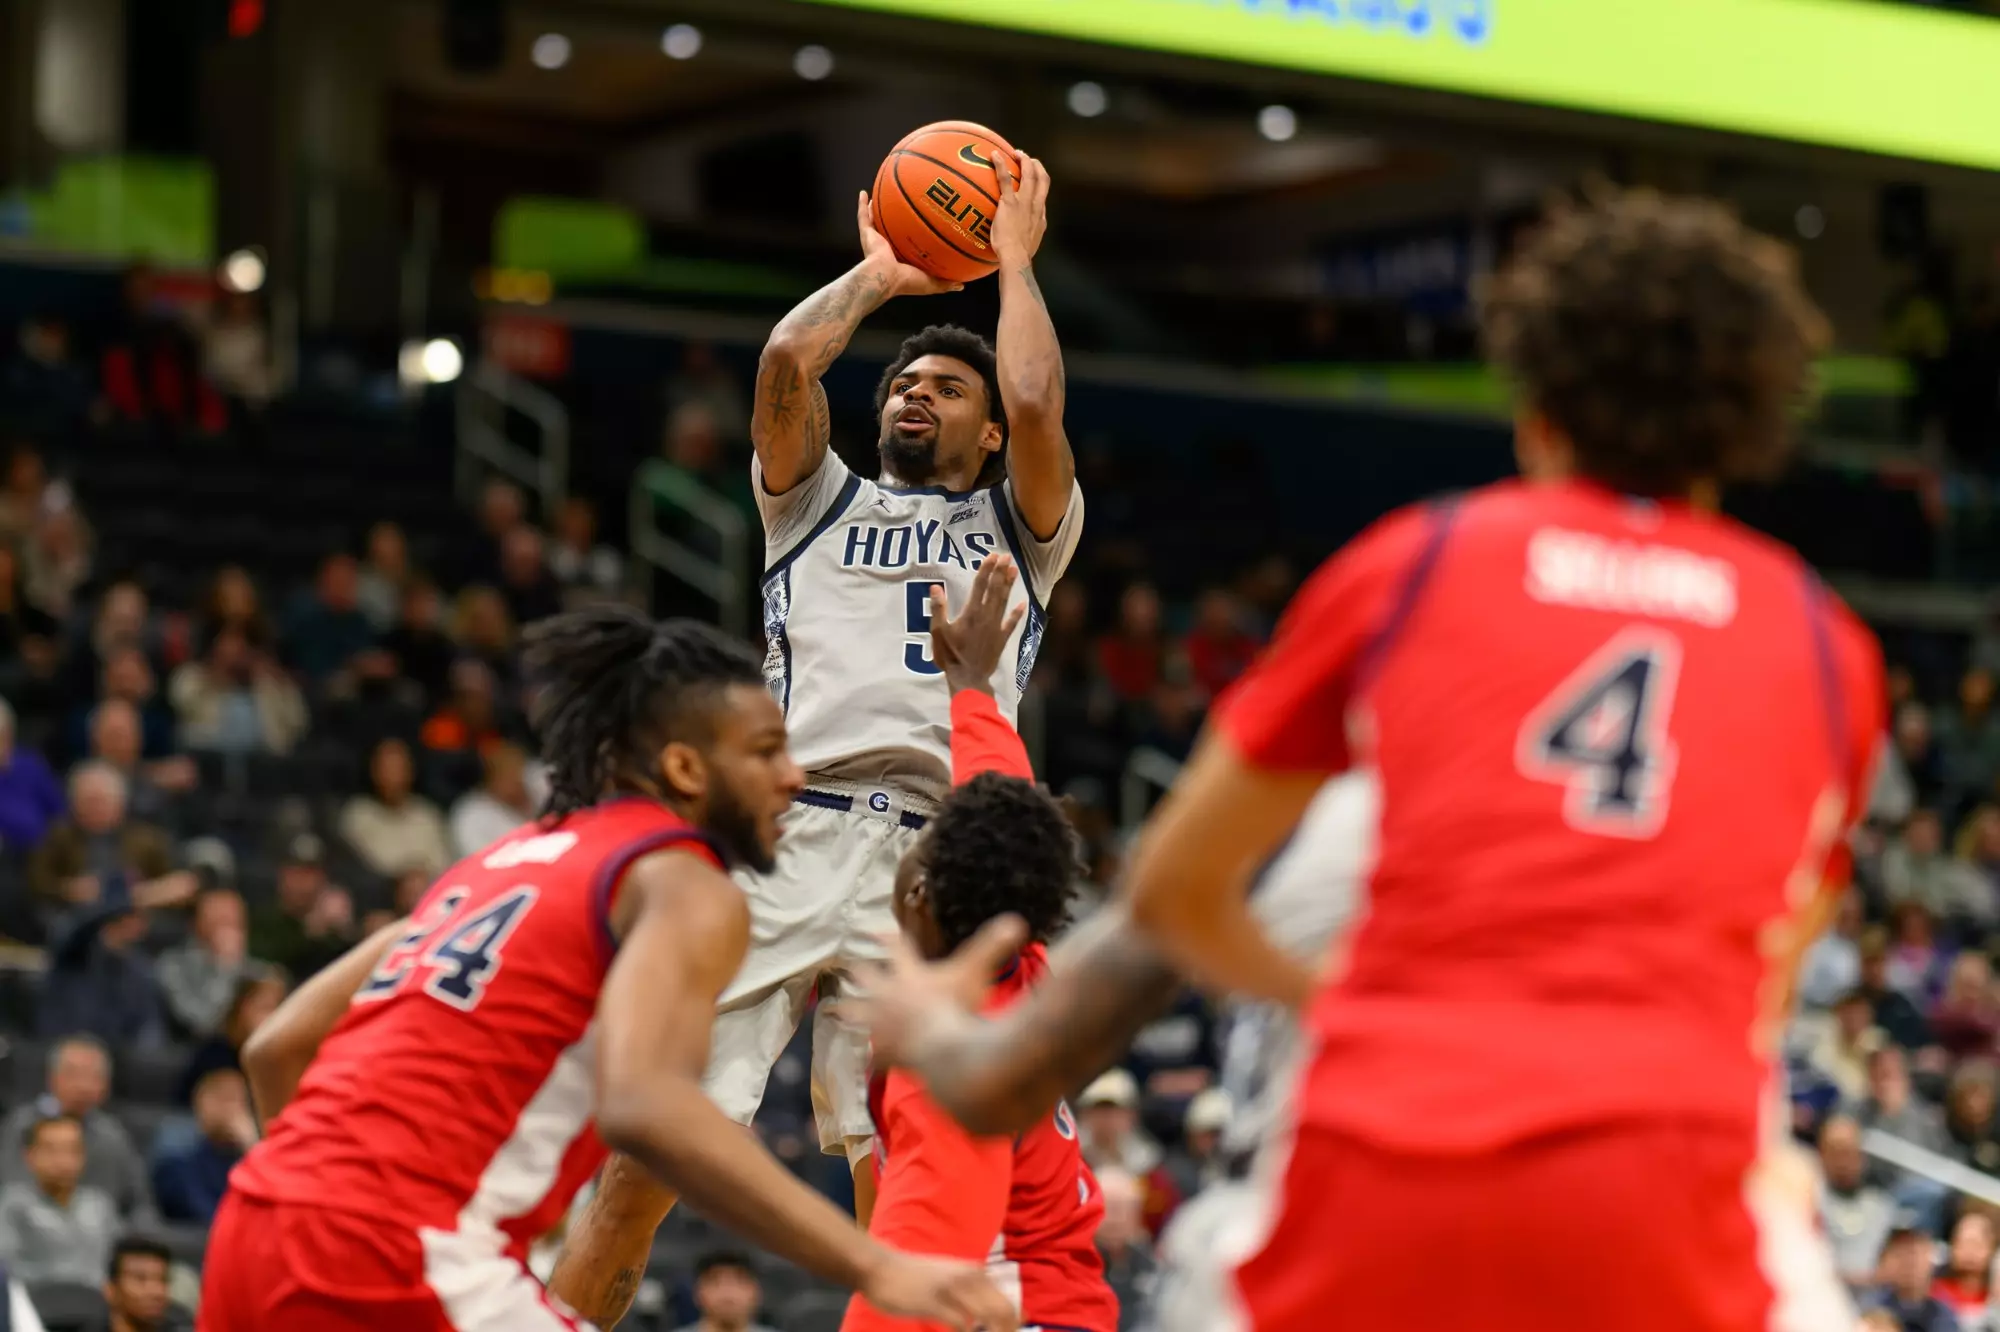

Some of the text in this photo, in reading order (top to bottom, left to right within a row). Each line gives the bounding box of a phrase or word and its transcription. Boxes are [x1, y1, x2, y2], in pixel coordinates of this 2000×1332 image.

[841, 518, 998, 572] HOYAS
[1513, 622, 1685, 842] 4
[867, 791, 892, 815] G
[353, 884, 541, 1012] 24
